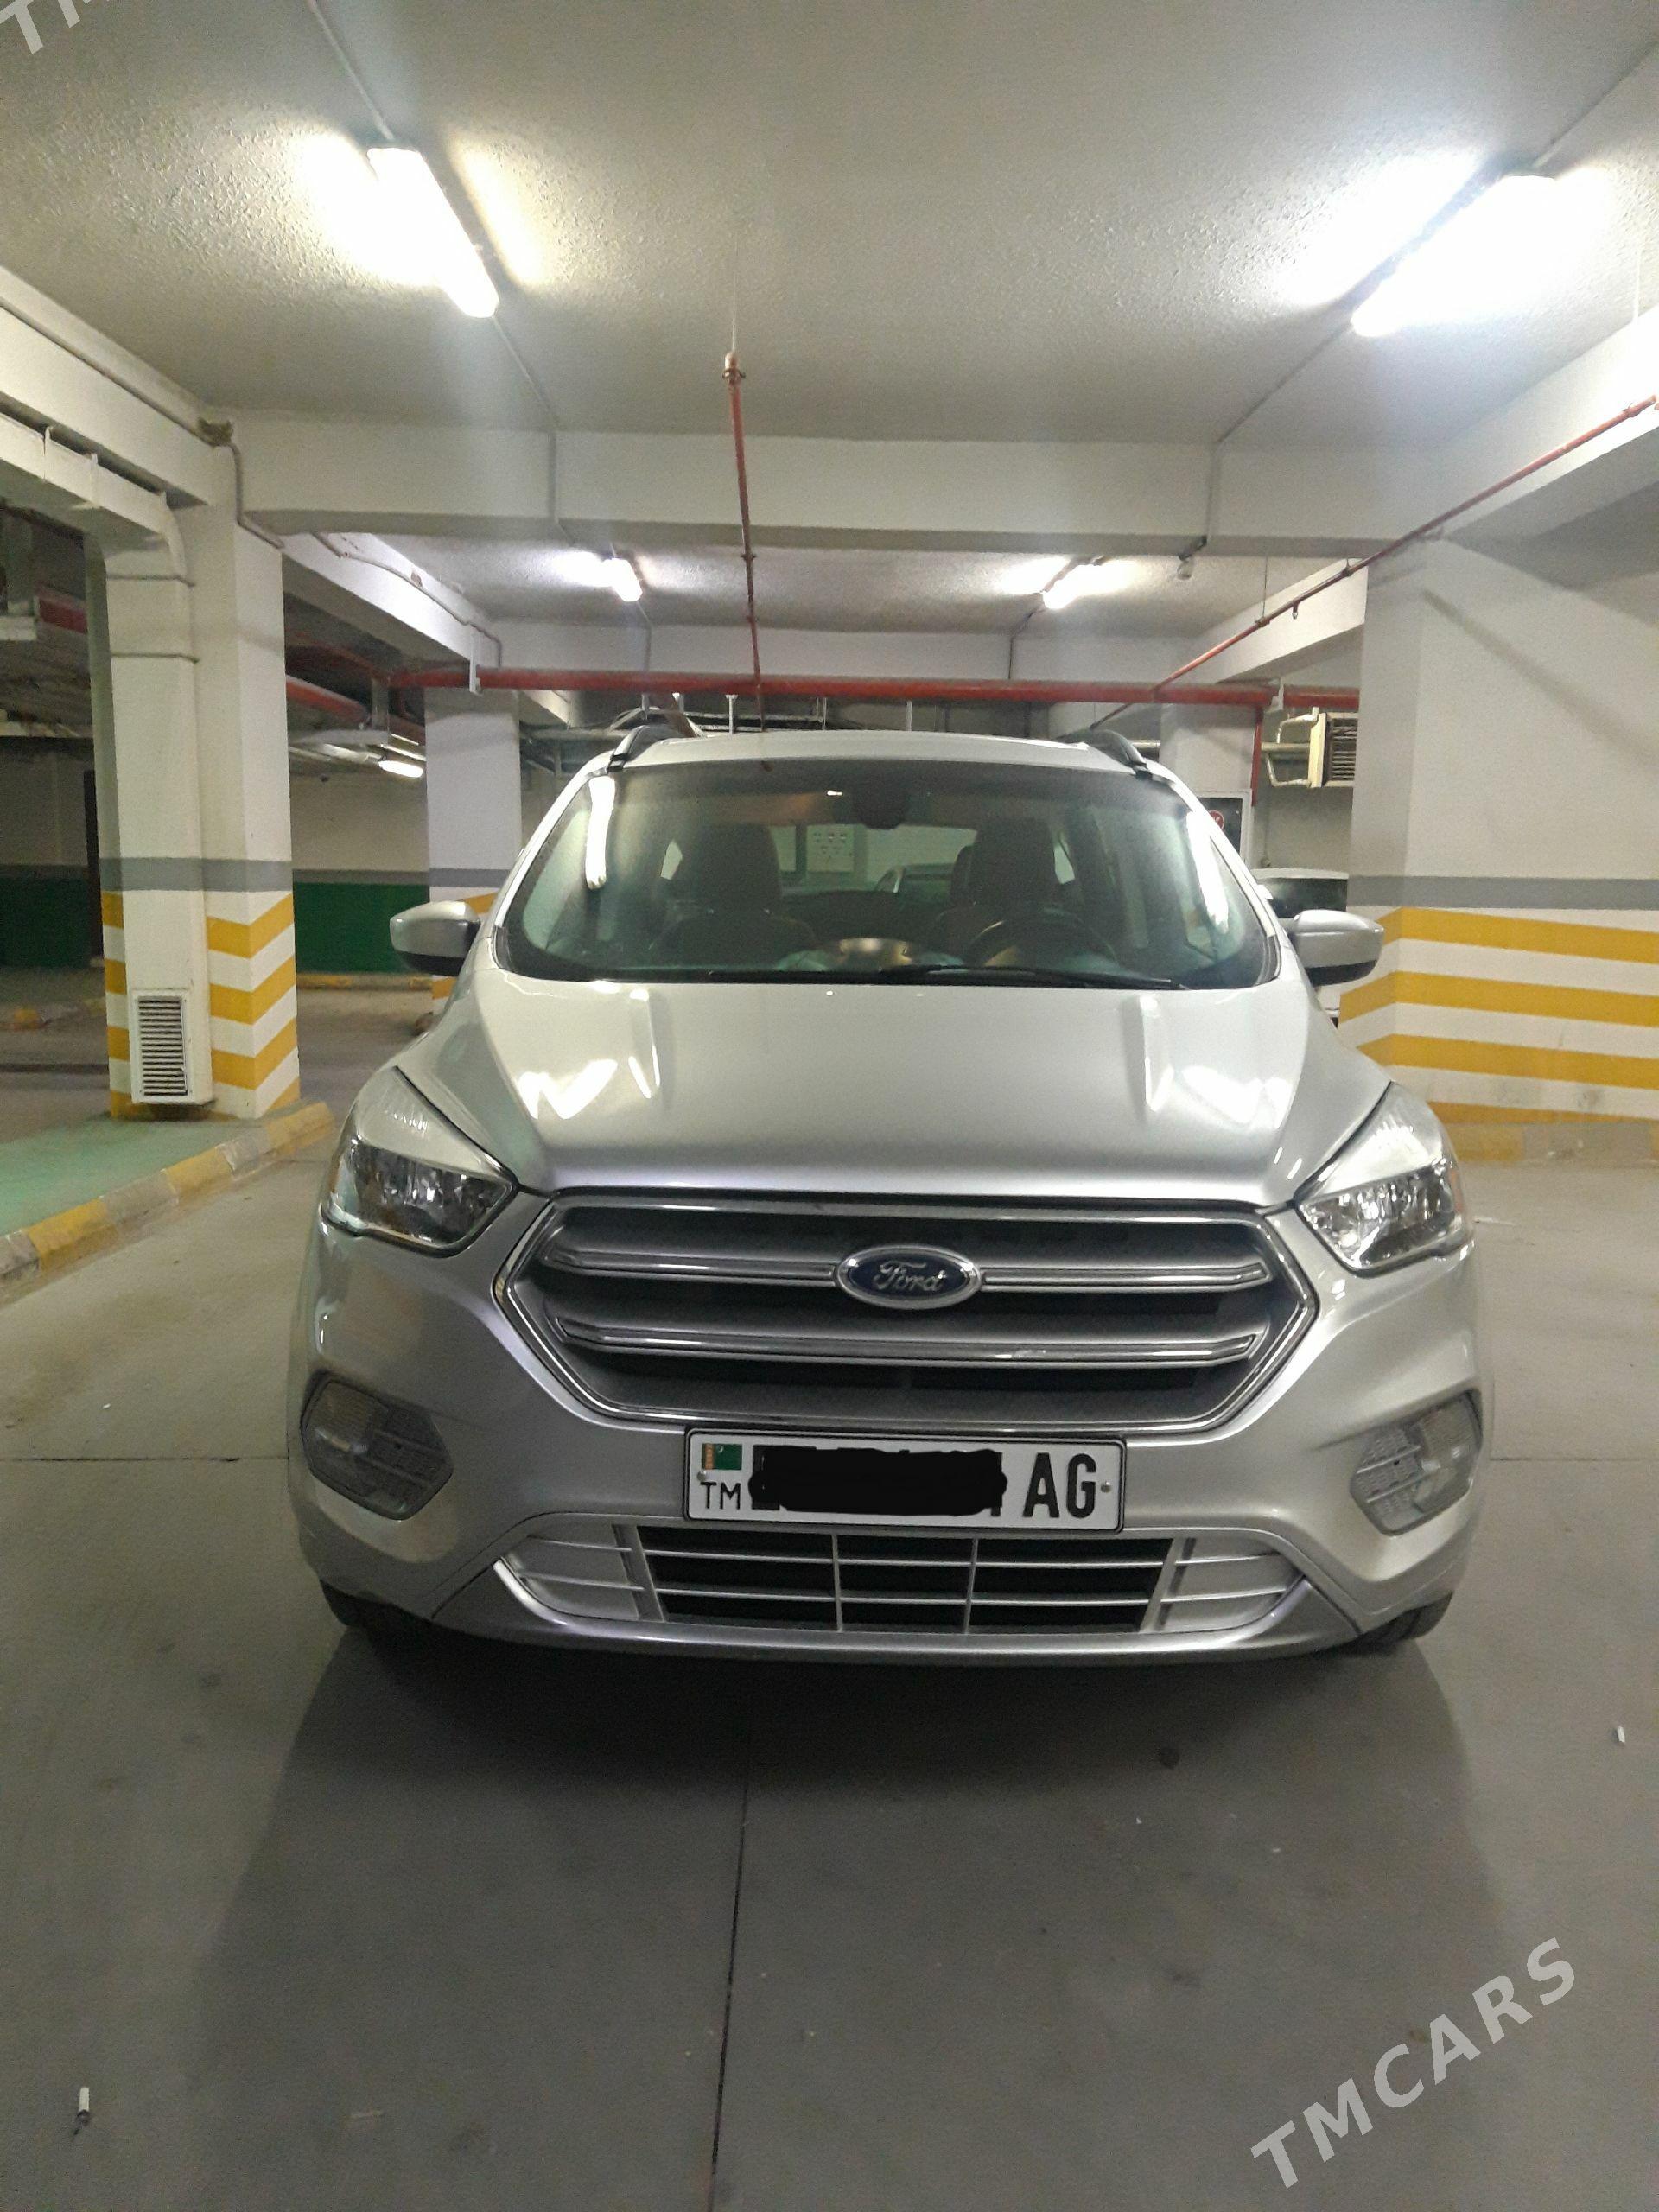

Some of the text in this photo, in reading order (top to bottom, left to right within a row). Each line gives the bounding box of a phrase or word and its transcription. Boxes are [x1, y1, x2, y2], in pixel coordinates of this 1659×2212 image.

[874, 1260, 947, 1292] Ford
[701, 1482, 741, 1510] TM
[1022, 1452, 1096, 1519] AG
